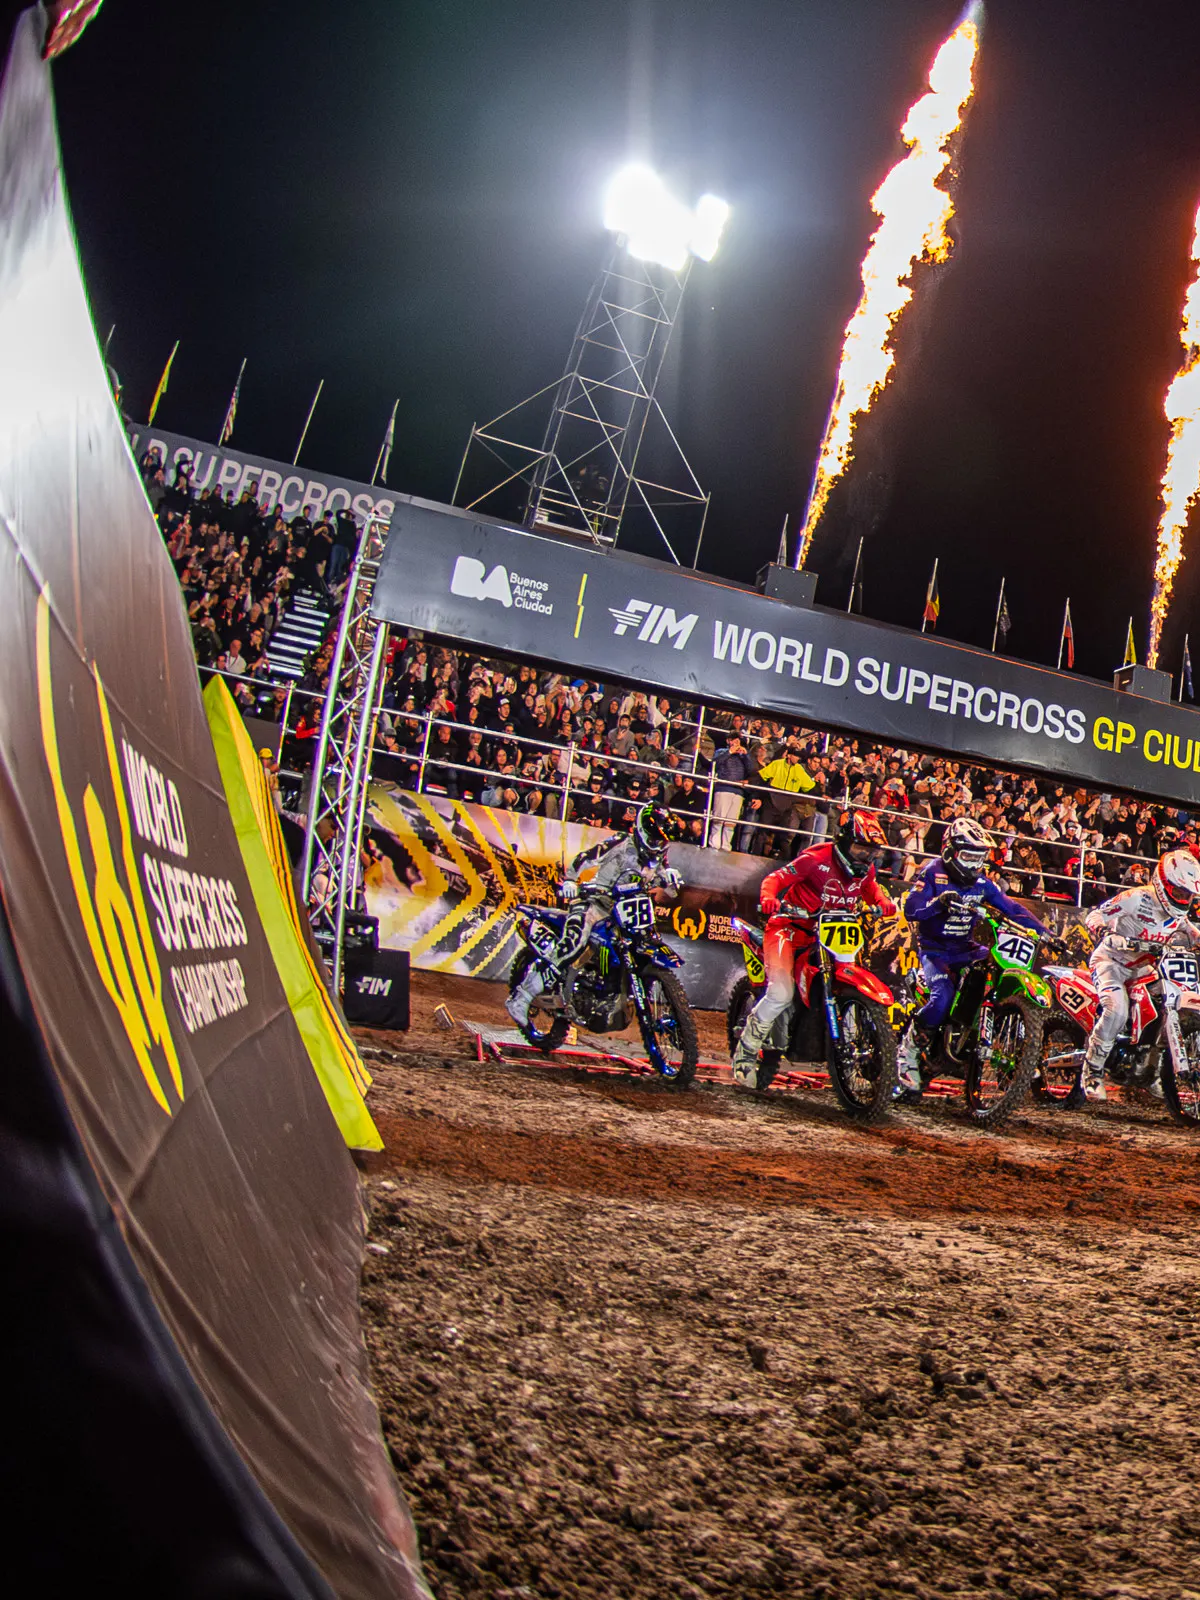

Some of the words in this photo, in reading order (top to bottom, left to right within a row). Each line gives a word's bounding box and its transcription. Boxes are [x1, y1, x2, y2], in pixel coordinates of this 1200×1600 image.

[510, 572, 549, 592] Buenos
[513, 585, 543, 601] Aires
[514, 597, 553, 615] Ciudad
[608, 599, 699, 650] FIM
[713, 620, 850, 687] WORLD
[855, 657, 1087, 744] SUPERCROSS
[1093, 716, 1136, 753] GP
[121, 737, 188, 858] WORLD
[142, 852, 248, 951] SUPERCROSS
[654, 906, 671, 917] FIM
[622, 898, 652, 930] 38
[823, 926, 860, 947] 719
[997, 937, 1034, 966] 46
[747, 955, 763, 976] 719
[1168, 959, 1198, 983] 29
[355, 976, 393, 997] FIM
[1061, 987, 1084, 1010] 29
